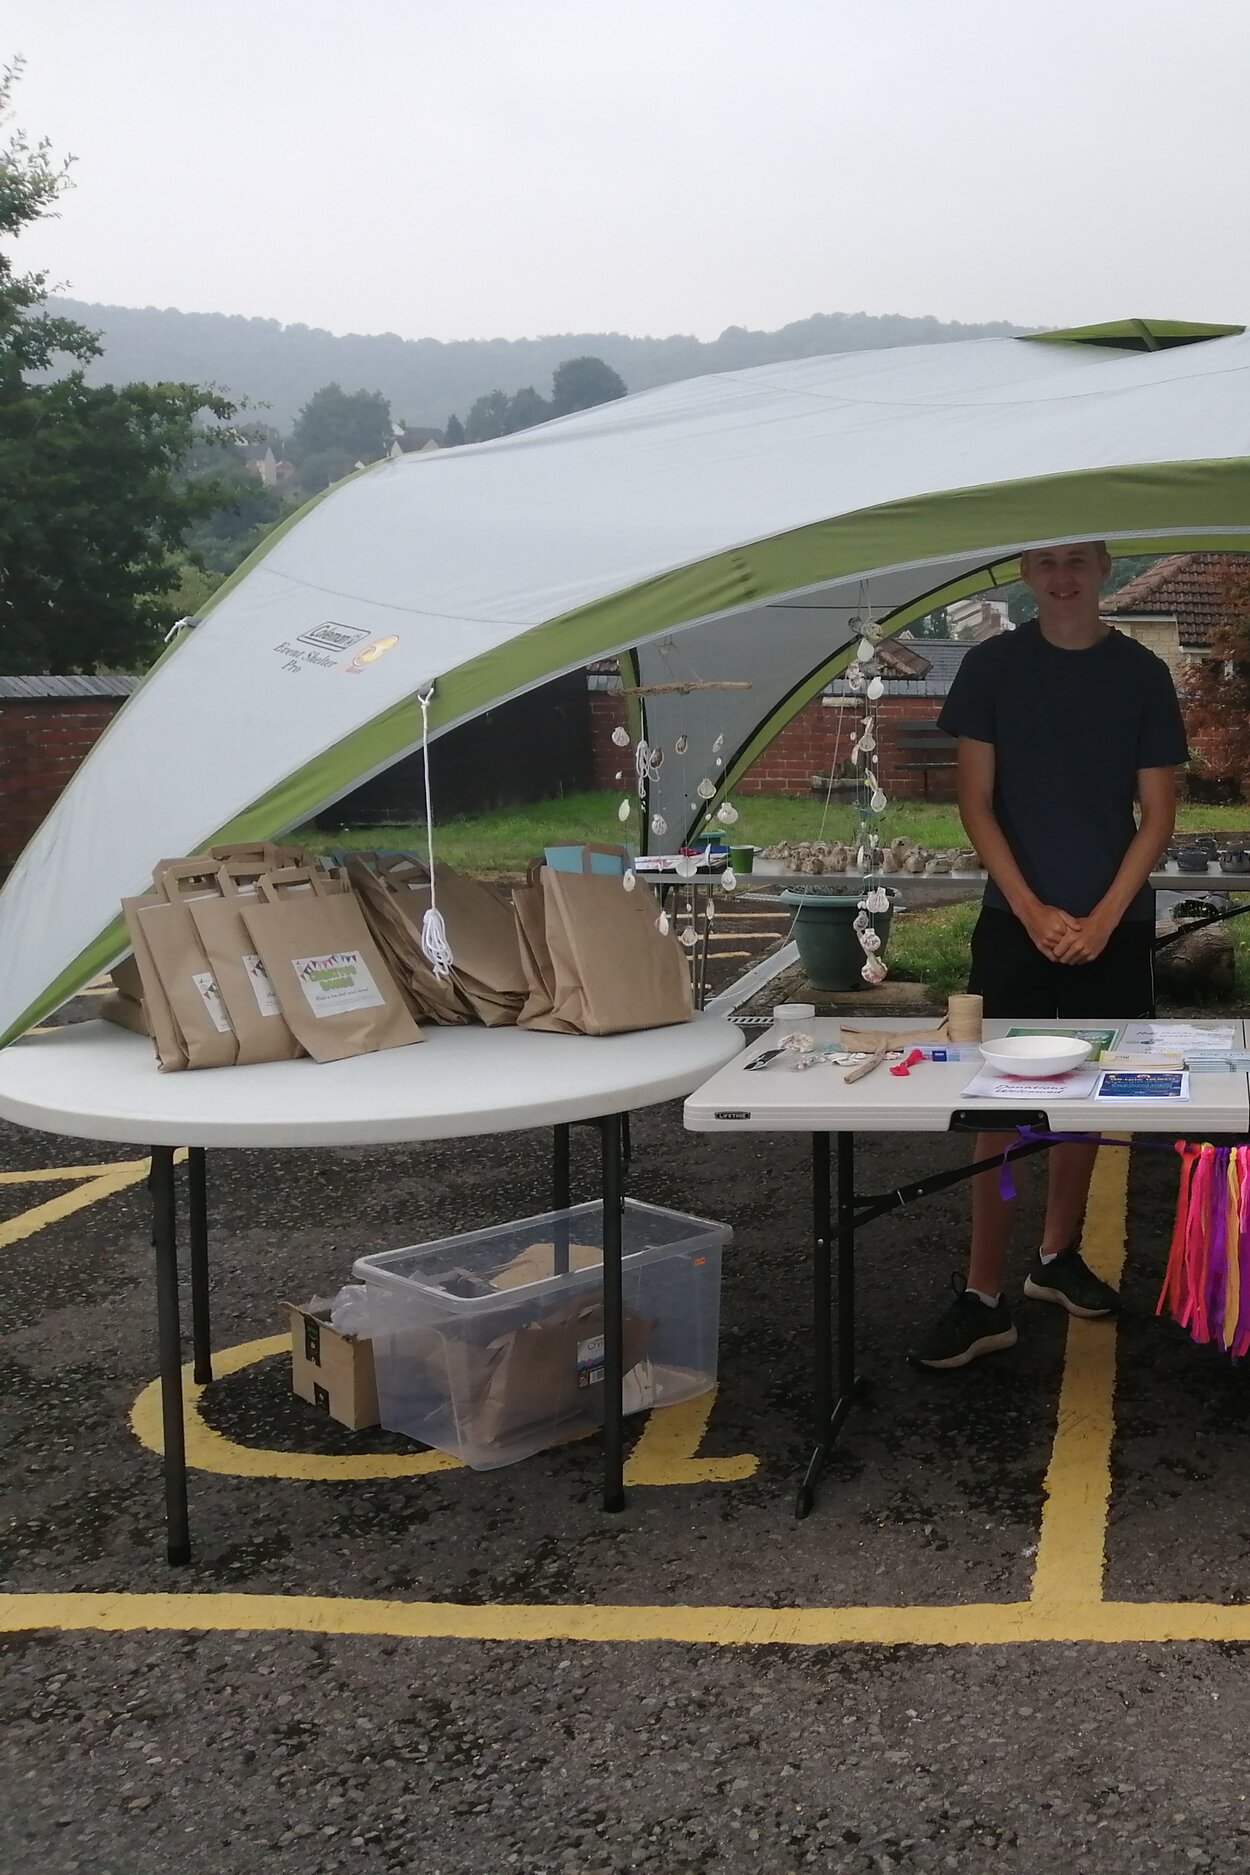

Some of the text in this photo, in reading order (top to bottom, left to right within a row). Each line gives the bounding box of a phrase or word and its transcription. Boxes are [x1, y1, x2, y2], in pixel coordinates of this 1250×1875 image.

[308, 624, 355, 645] Coleman
[273, 641, 338, 668] Event Shelter
[282, 659, 302, 673] Pro
